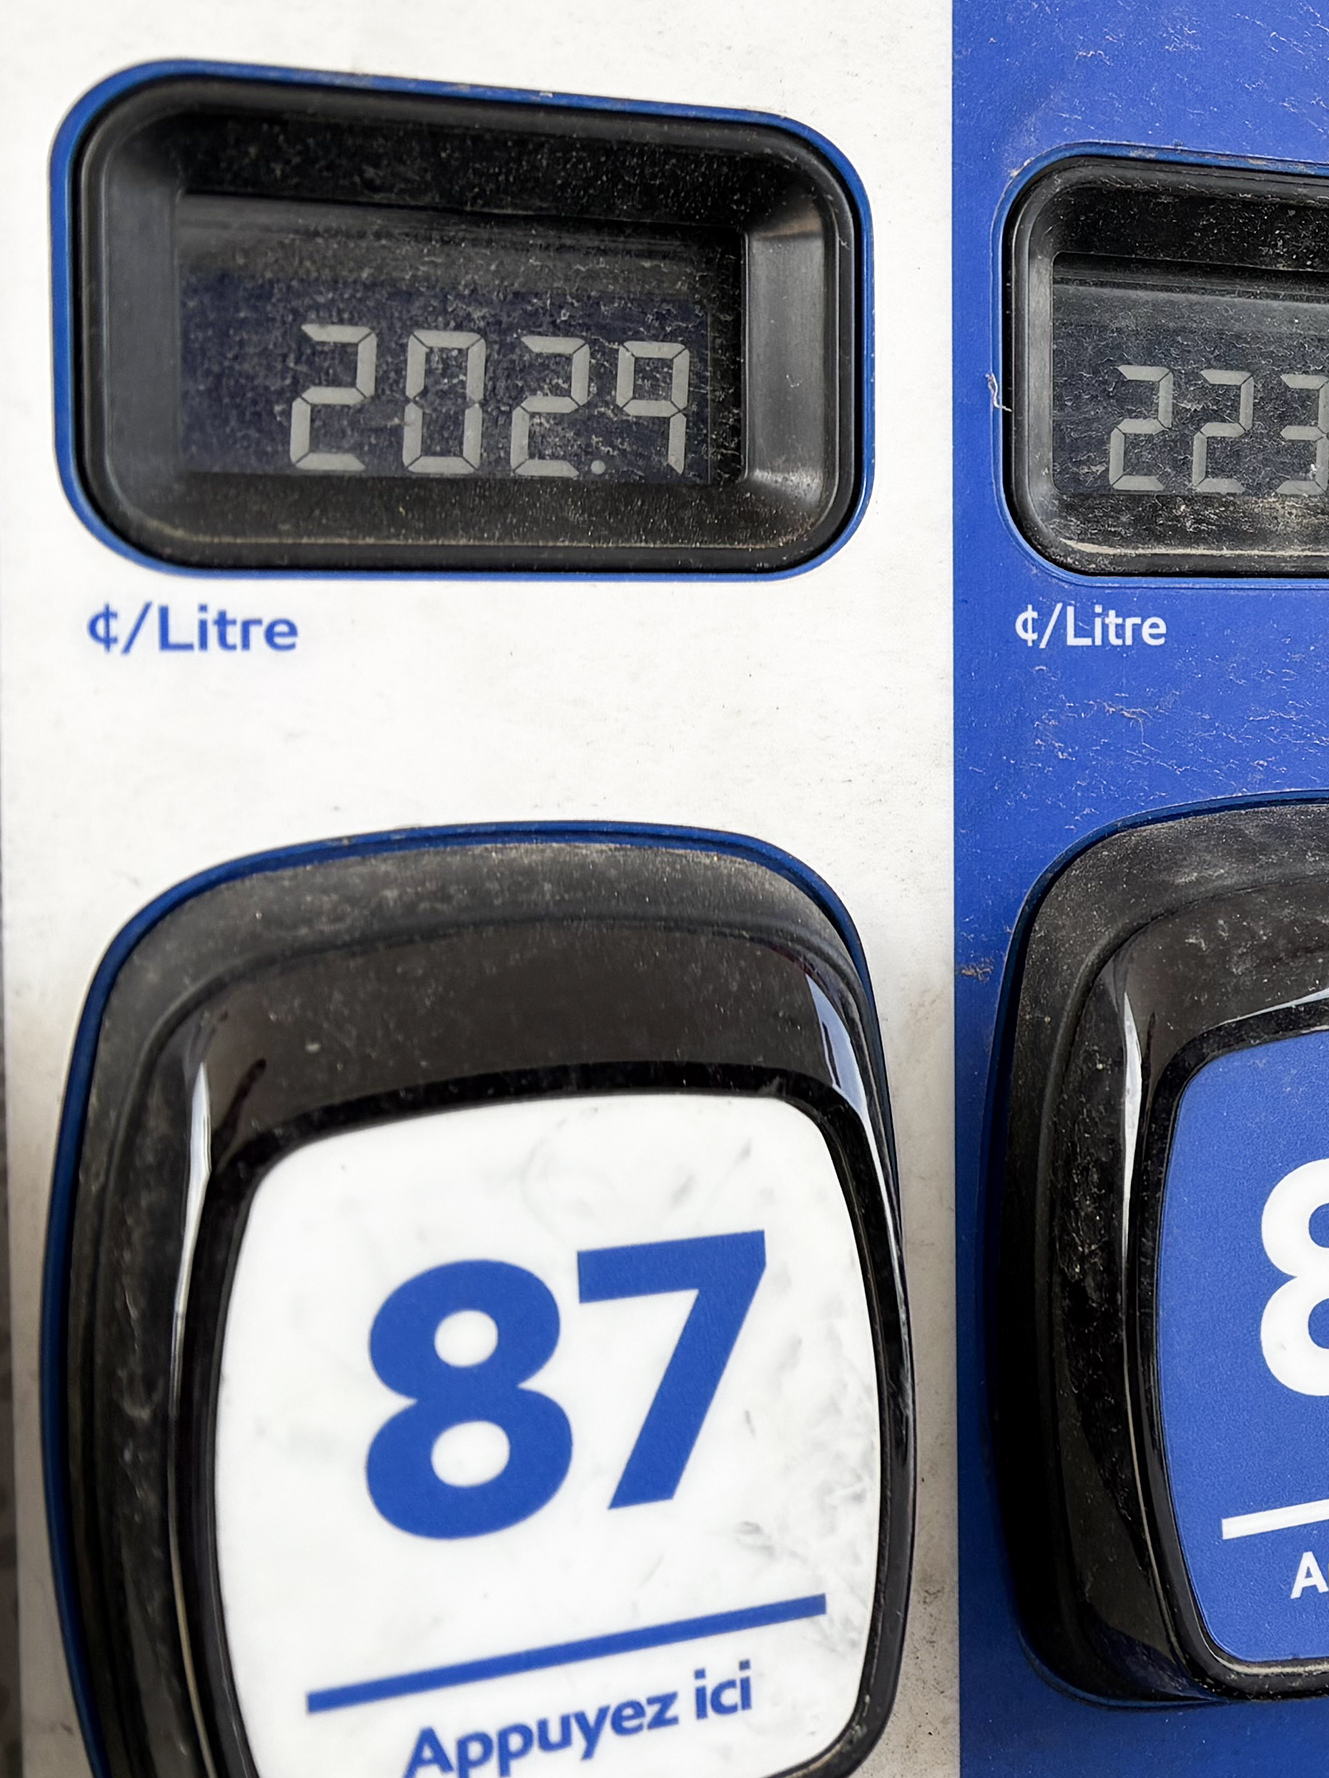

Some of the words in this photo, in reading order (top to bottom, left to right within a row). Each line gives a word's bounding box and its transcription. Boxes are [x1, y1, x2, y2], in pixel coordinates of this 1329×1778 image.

[290, 325, 689, 478] 202.9
[88, 602, 298, 654] ¢/Litre
[1015, 602, 1167, 649] ¢/Litre
[365, 1229, 767, 1540] 87
[403, 1691, 679, 1778] Appuyez
[694, 1659, 752, 1720] ici
